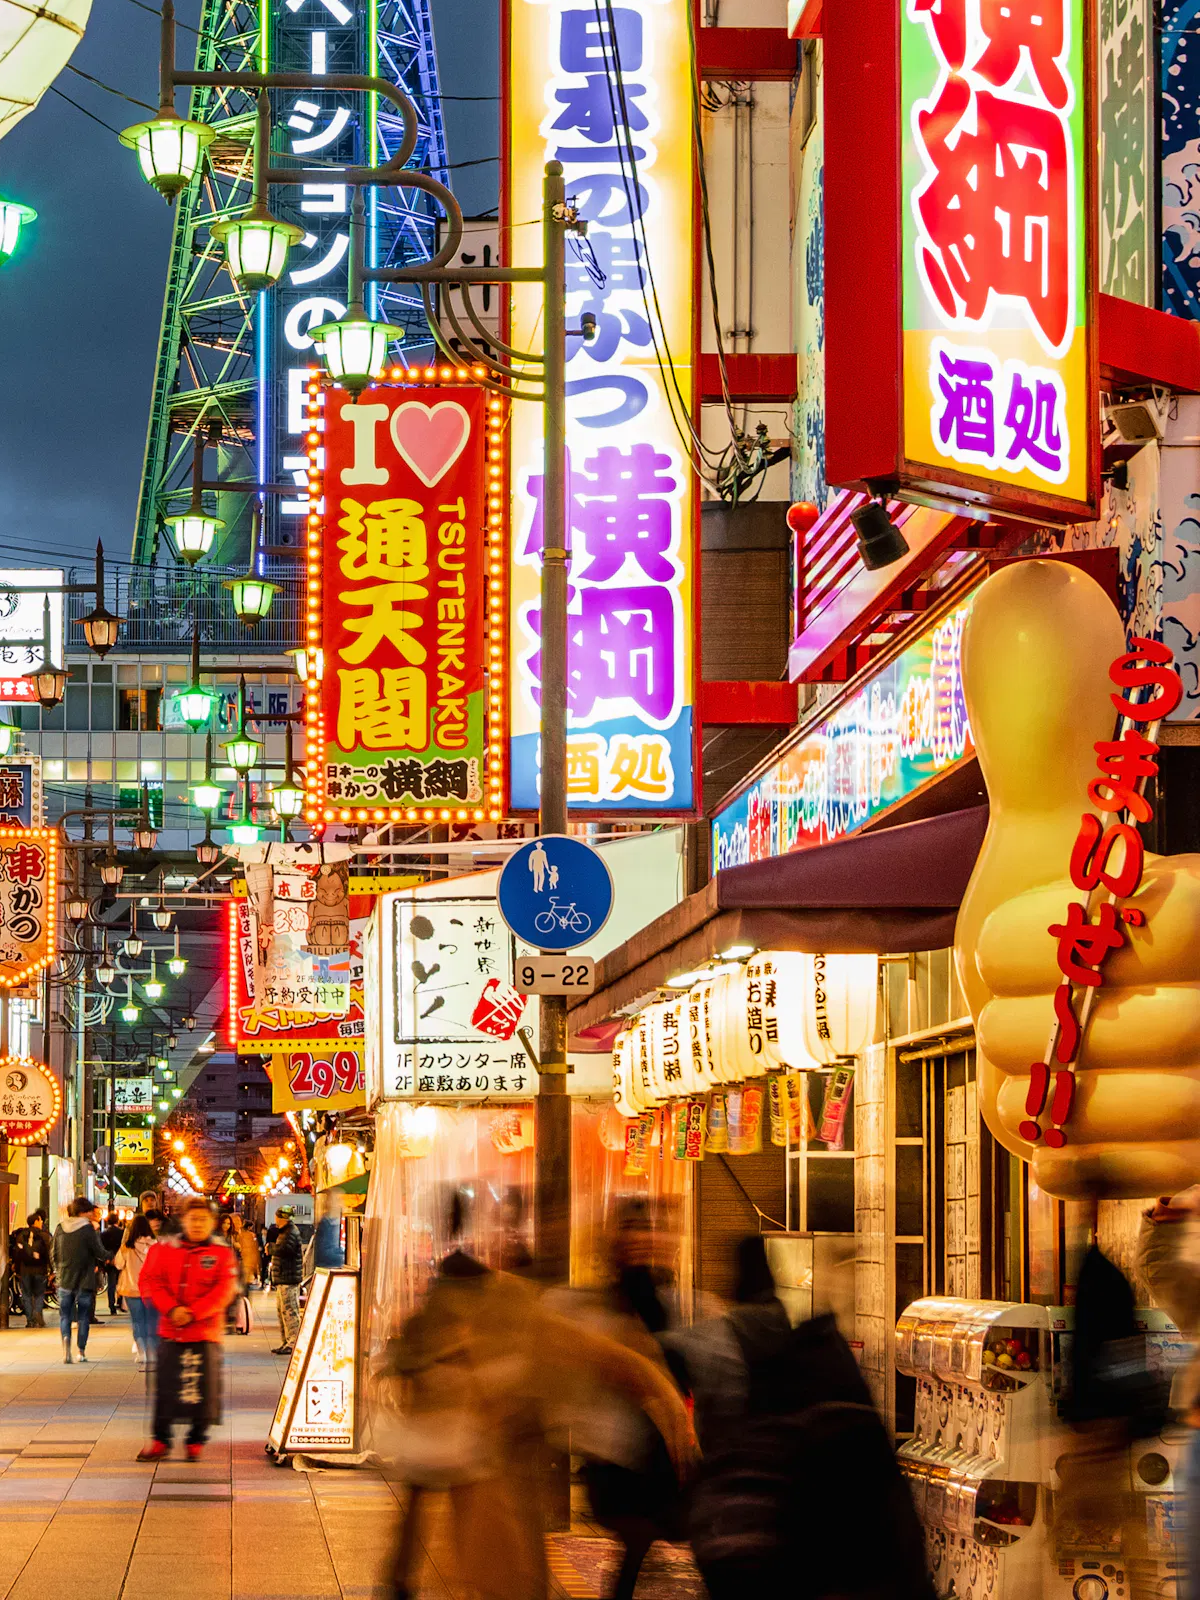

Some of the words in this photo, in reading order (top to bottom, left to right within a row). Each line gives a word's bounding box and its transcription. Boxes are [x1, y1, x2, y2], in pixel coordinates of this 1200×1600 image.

[550, 7, 653, 429] 日本一の串かつ
[939, 350, 1063, 474] 酒処
[340, 402, 390, 487] I
[523, 442, 677, 722] 横綱
[337, 497, 430, 751] 通天閣
[437, 496, 468, 747] TSUTENKAKU
[326, 764, 379, 780] 日本一の
[326, 781, 378, 798] 串かつ
[380, 758, 469, 802] 横綱
[7, 842, 46, 942] 串かつ
[277, 880, 316, 900] 本店
[473, 916, 501, 974] 新世界
[395, 1075, 412, 1091] 2F
[418, 1075, 527, 1092] 座敷あります
[396, 1053, 412, 1068] 1F
[419, 1052, 527, 1069] カウンター席
[115, 1132, 150, 1156] 串かつ
